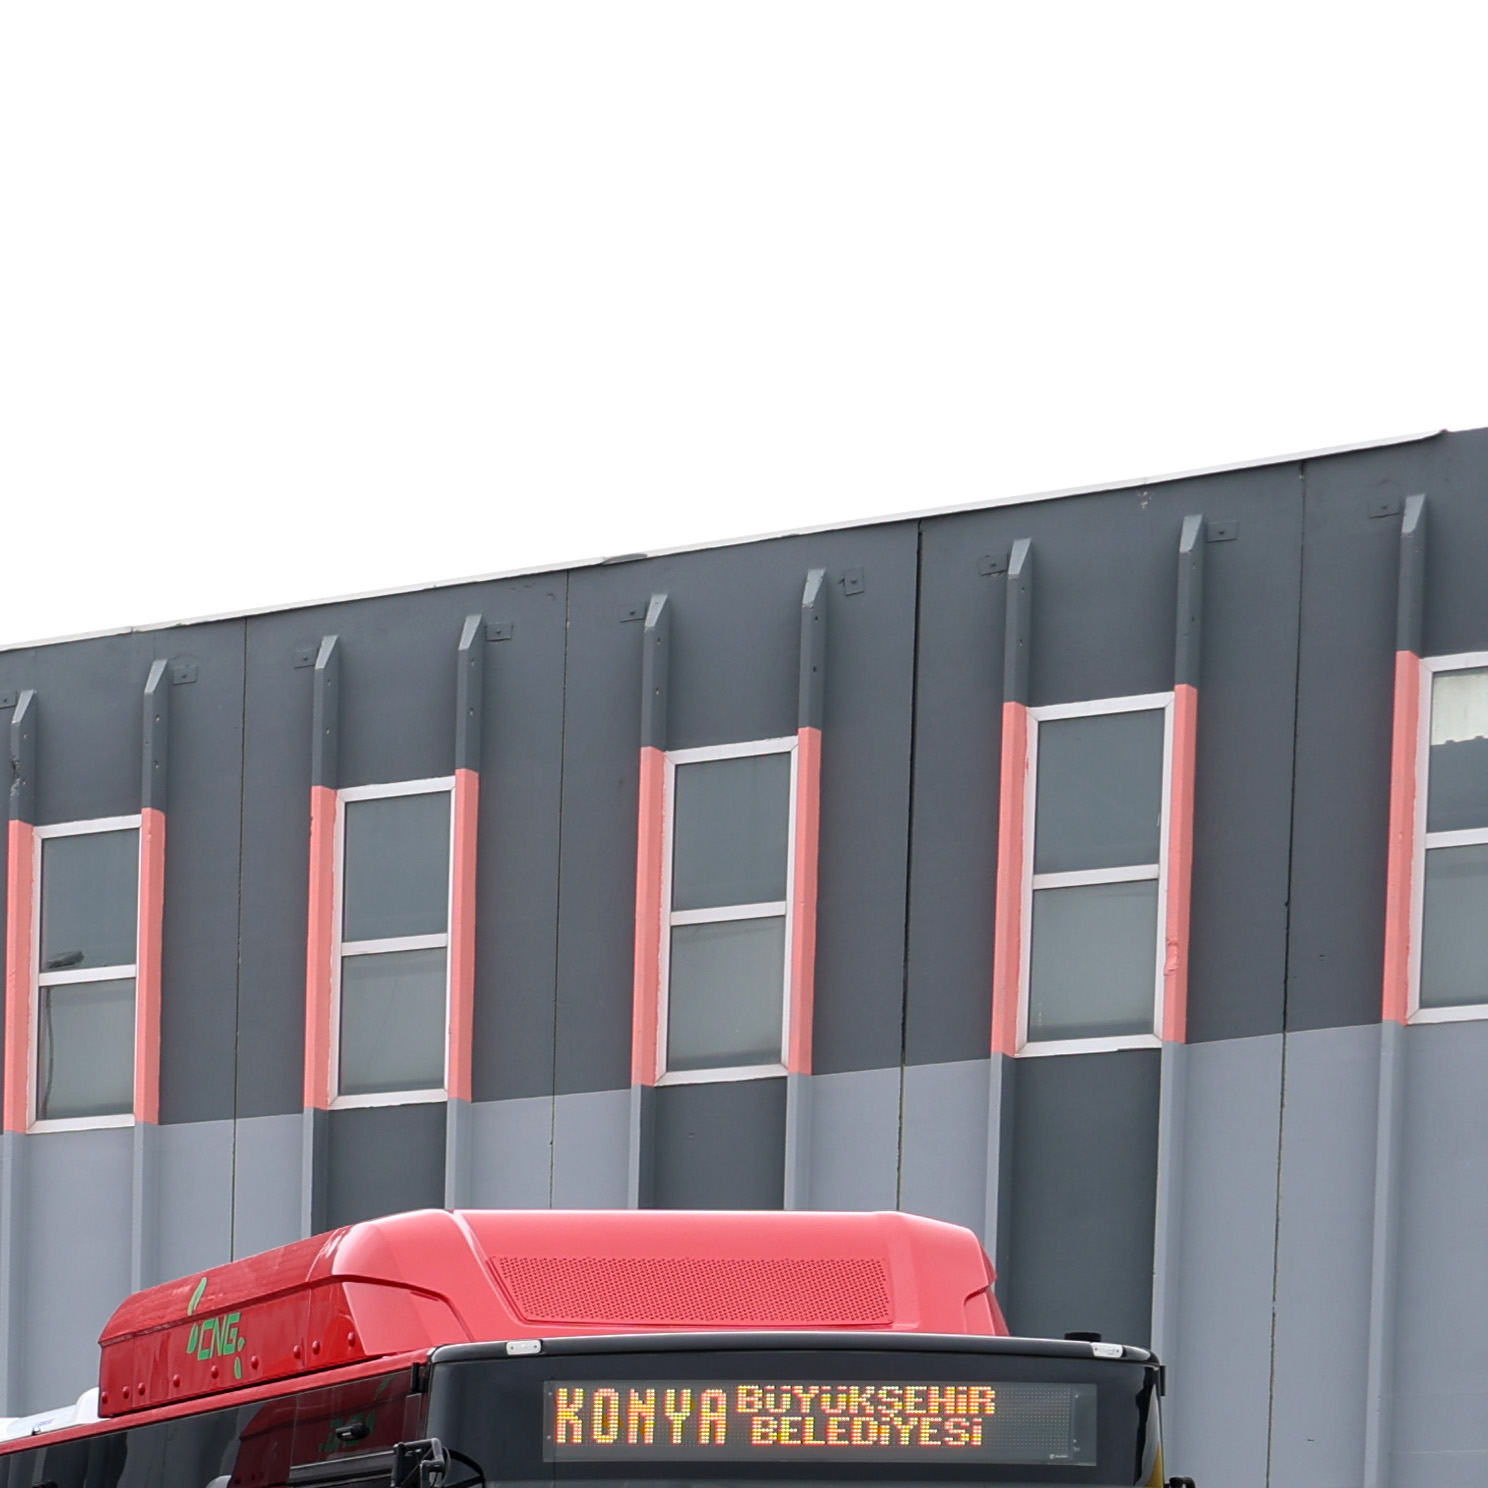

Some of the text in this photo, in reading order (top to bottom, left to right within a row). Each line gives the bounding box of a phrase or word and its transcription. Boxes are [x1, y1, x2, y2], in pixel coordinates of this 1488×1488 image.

[197, 1312, 241, 1361] CNG
[555, 1387, 727, 1444] KONYA
[737, 1385, 997, 1416] BÜYÜKŞEHİR
[751, 1416, 983, 1446] BELEDİYESİ
